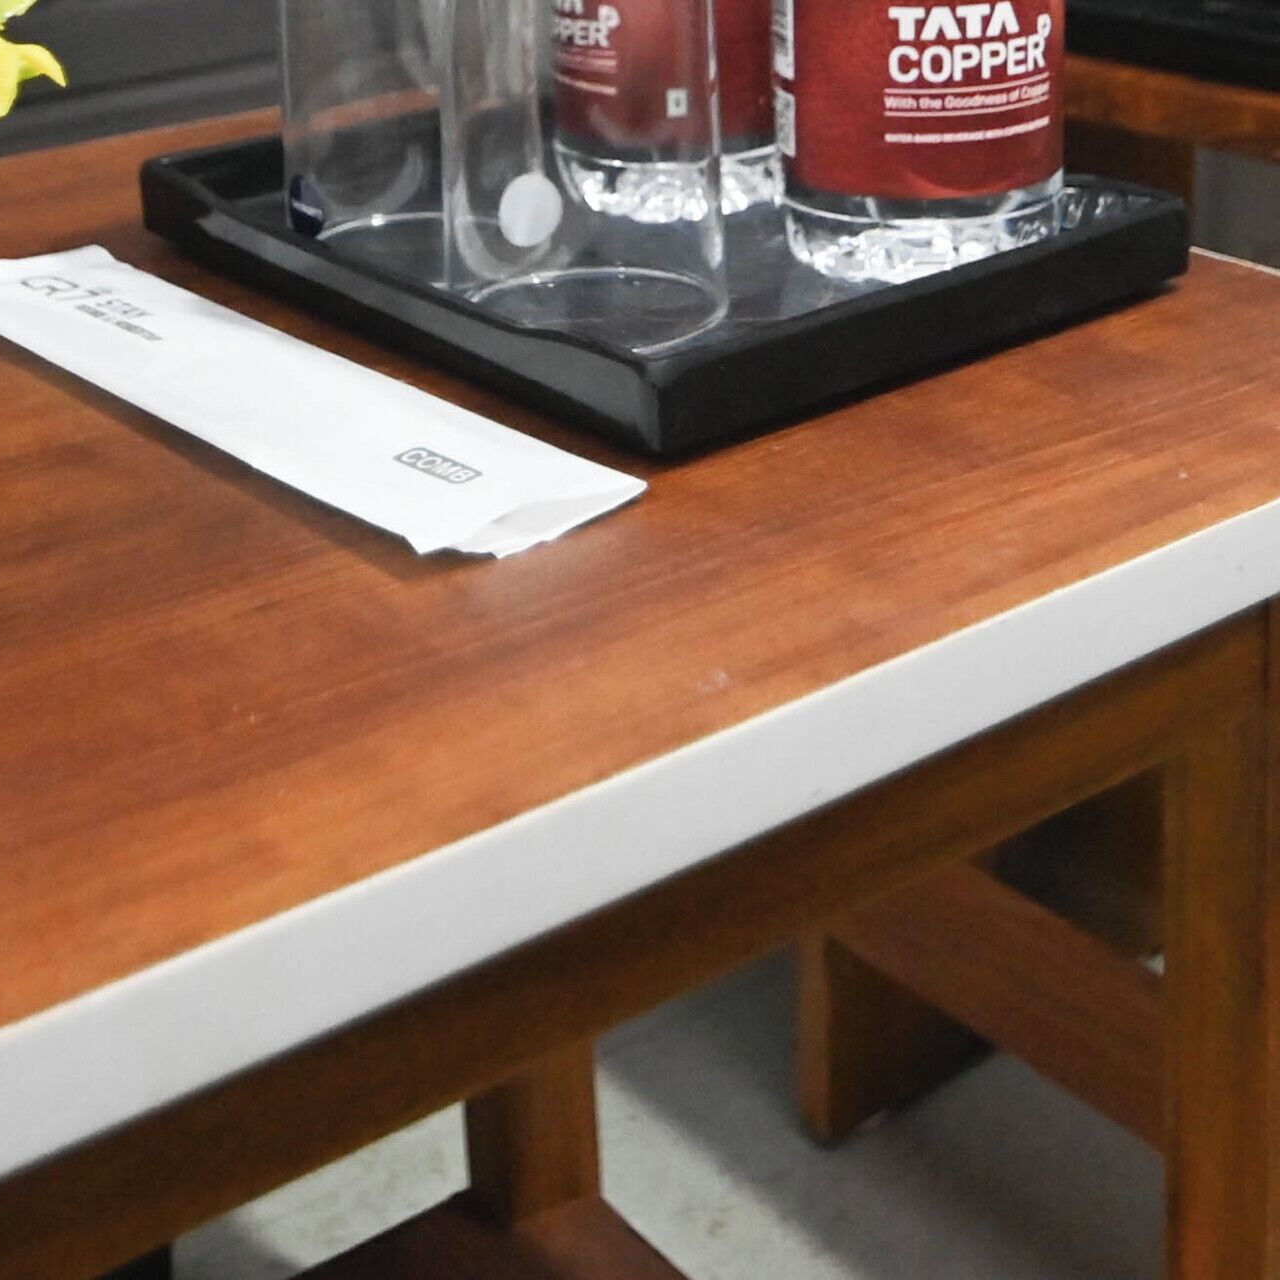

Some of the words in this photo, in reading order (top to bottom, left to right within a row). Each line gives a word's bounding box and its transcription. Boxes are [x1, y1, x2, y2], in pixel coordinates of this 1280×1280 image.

[888, 1, 1020, 41] TATA
[888, 33, 1046, 83] COPPER
[883, 94, 918, 110] With
[919, 95, 943, 110] the
[399, 448, 477, 483] COMB
